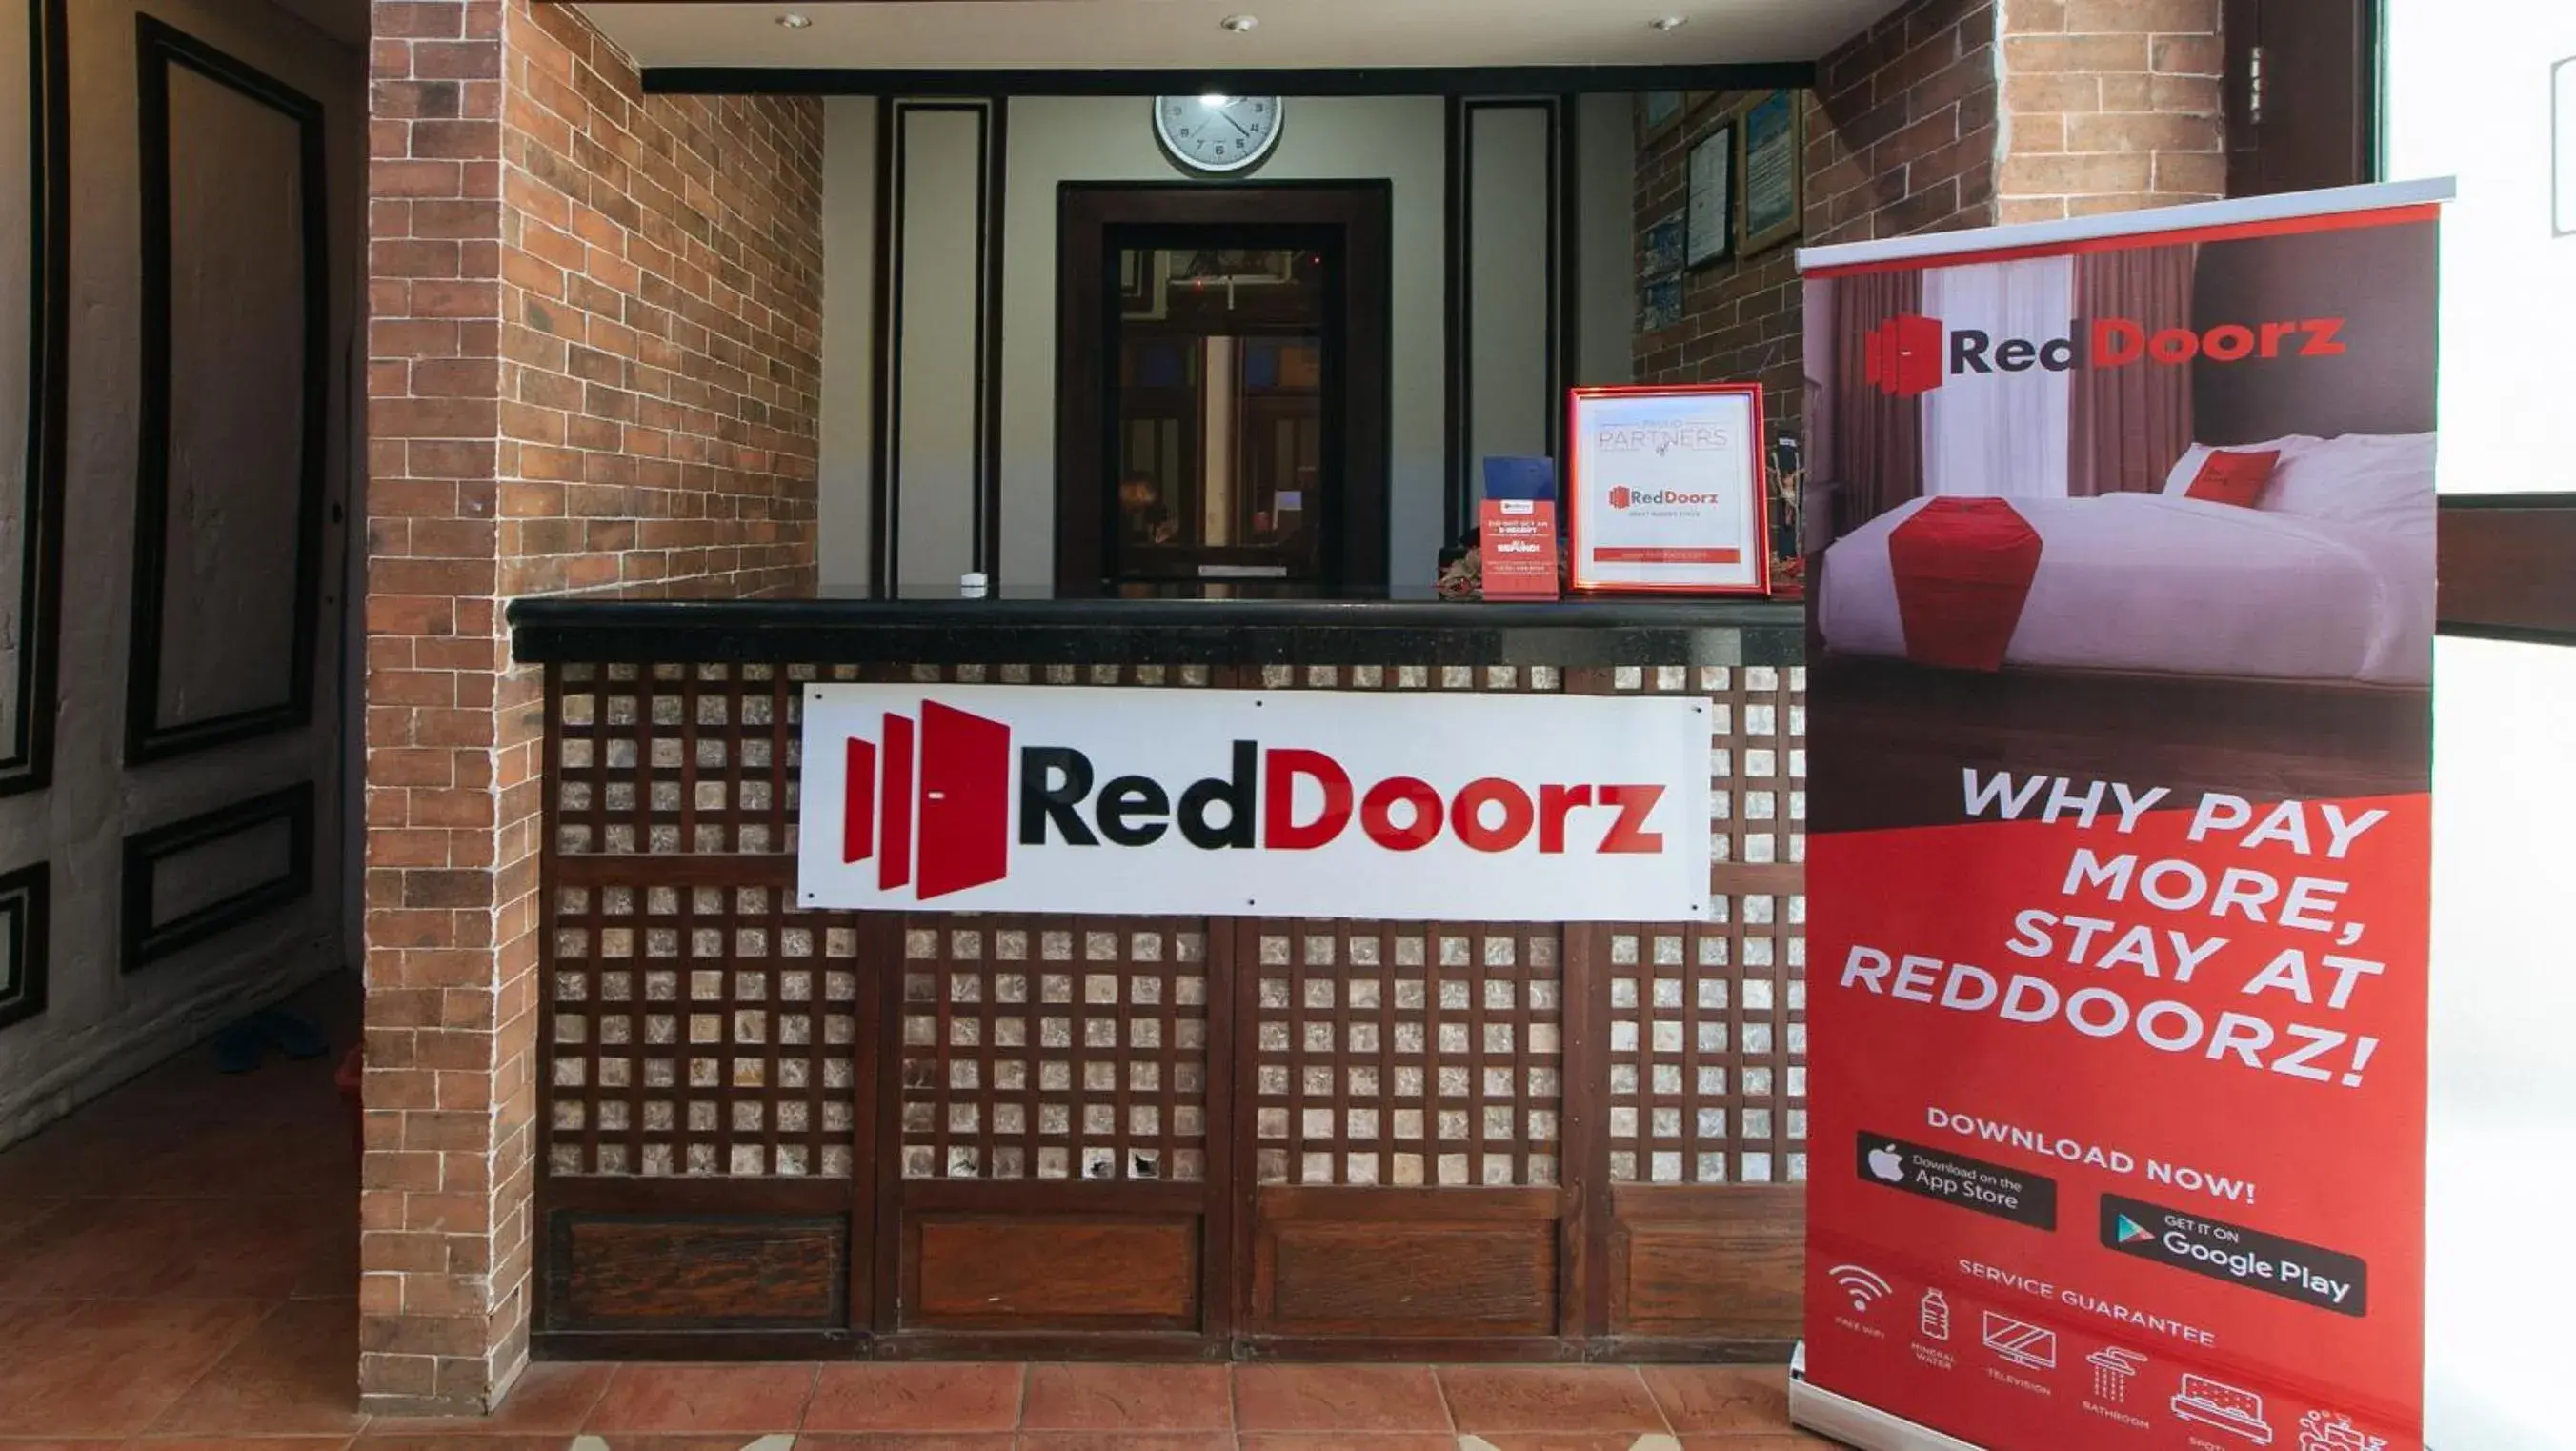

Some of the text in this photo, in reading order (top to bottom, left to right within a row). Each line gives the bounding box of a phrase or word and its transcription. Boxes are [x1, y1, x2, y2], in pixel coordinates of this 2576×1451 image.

[1197, 139, 1205, 150] 7
[1215, 145, 1225, 155] 6
[1236, 138, 1245, 149] 5
[1950, 317, 2347, 375] RedDoorz
[1600, 429, 1729, 448] PARTNERS
[1631, 489, 1719, 505] RedDoorz
[1018, 739, 1667, 854] RedDoorz
[1962, 768, 2389, 858] WHY PAY
[2062, 849, 2365, 945] MORE,
[2005, 910, 2385, 1011] STAY AT
[1841, 945, 2380, 1088] REDDOORZ!
[1913, 1154, 2023, 1193] Download on the
[1927, 1106, 2256, 1205] DOWNLOAD NOW!
[1916, 1169, 2019, 1210] App Store
[2163, 1215, 2240, 1244] GET IT ON
[2163, 1231, 2351, 1304] Google Play
[1959, 1259, 2217, 1348] SERVICE GUARANTEE
[1910, 1341, 1956, 1363] MINERAL
[1915, 1352, 1953, 1371] WATER
[1988, 1367, 2052, 1396] TELEVISION
[2082, 1400, 2150, 1430] BATHROOM
